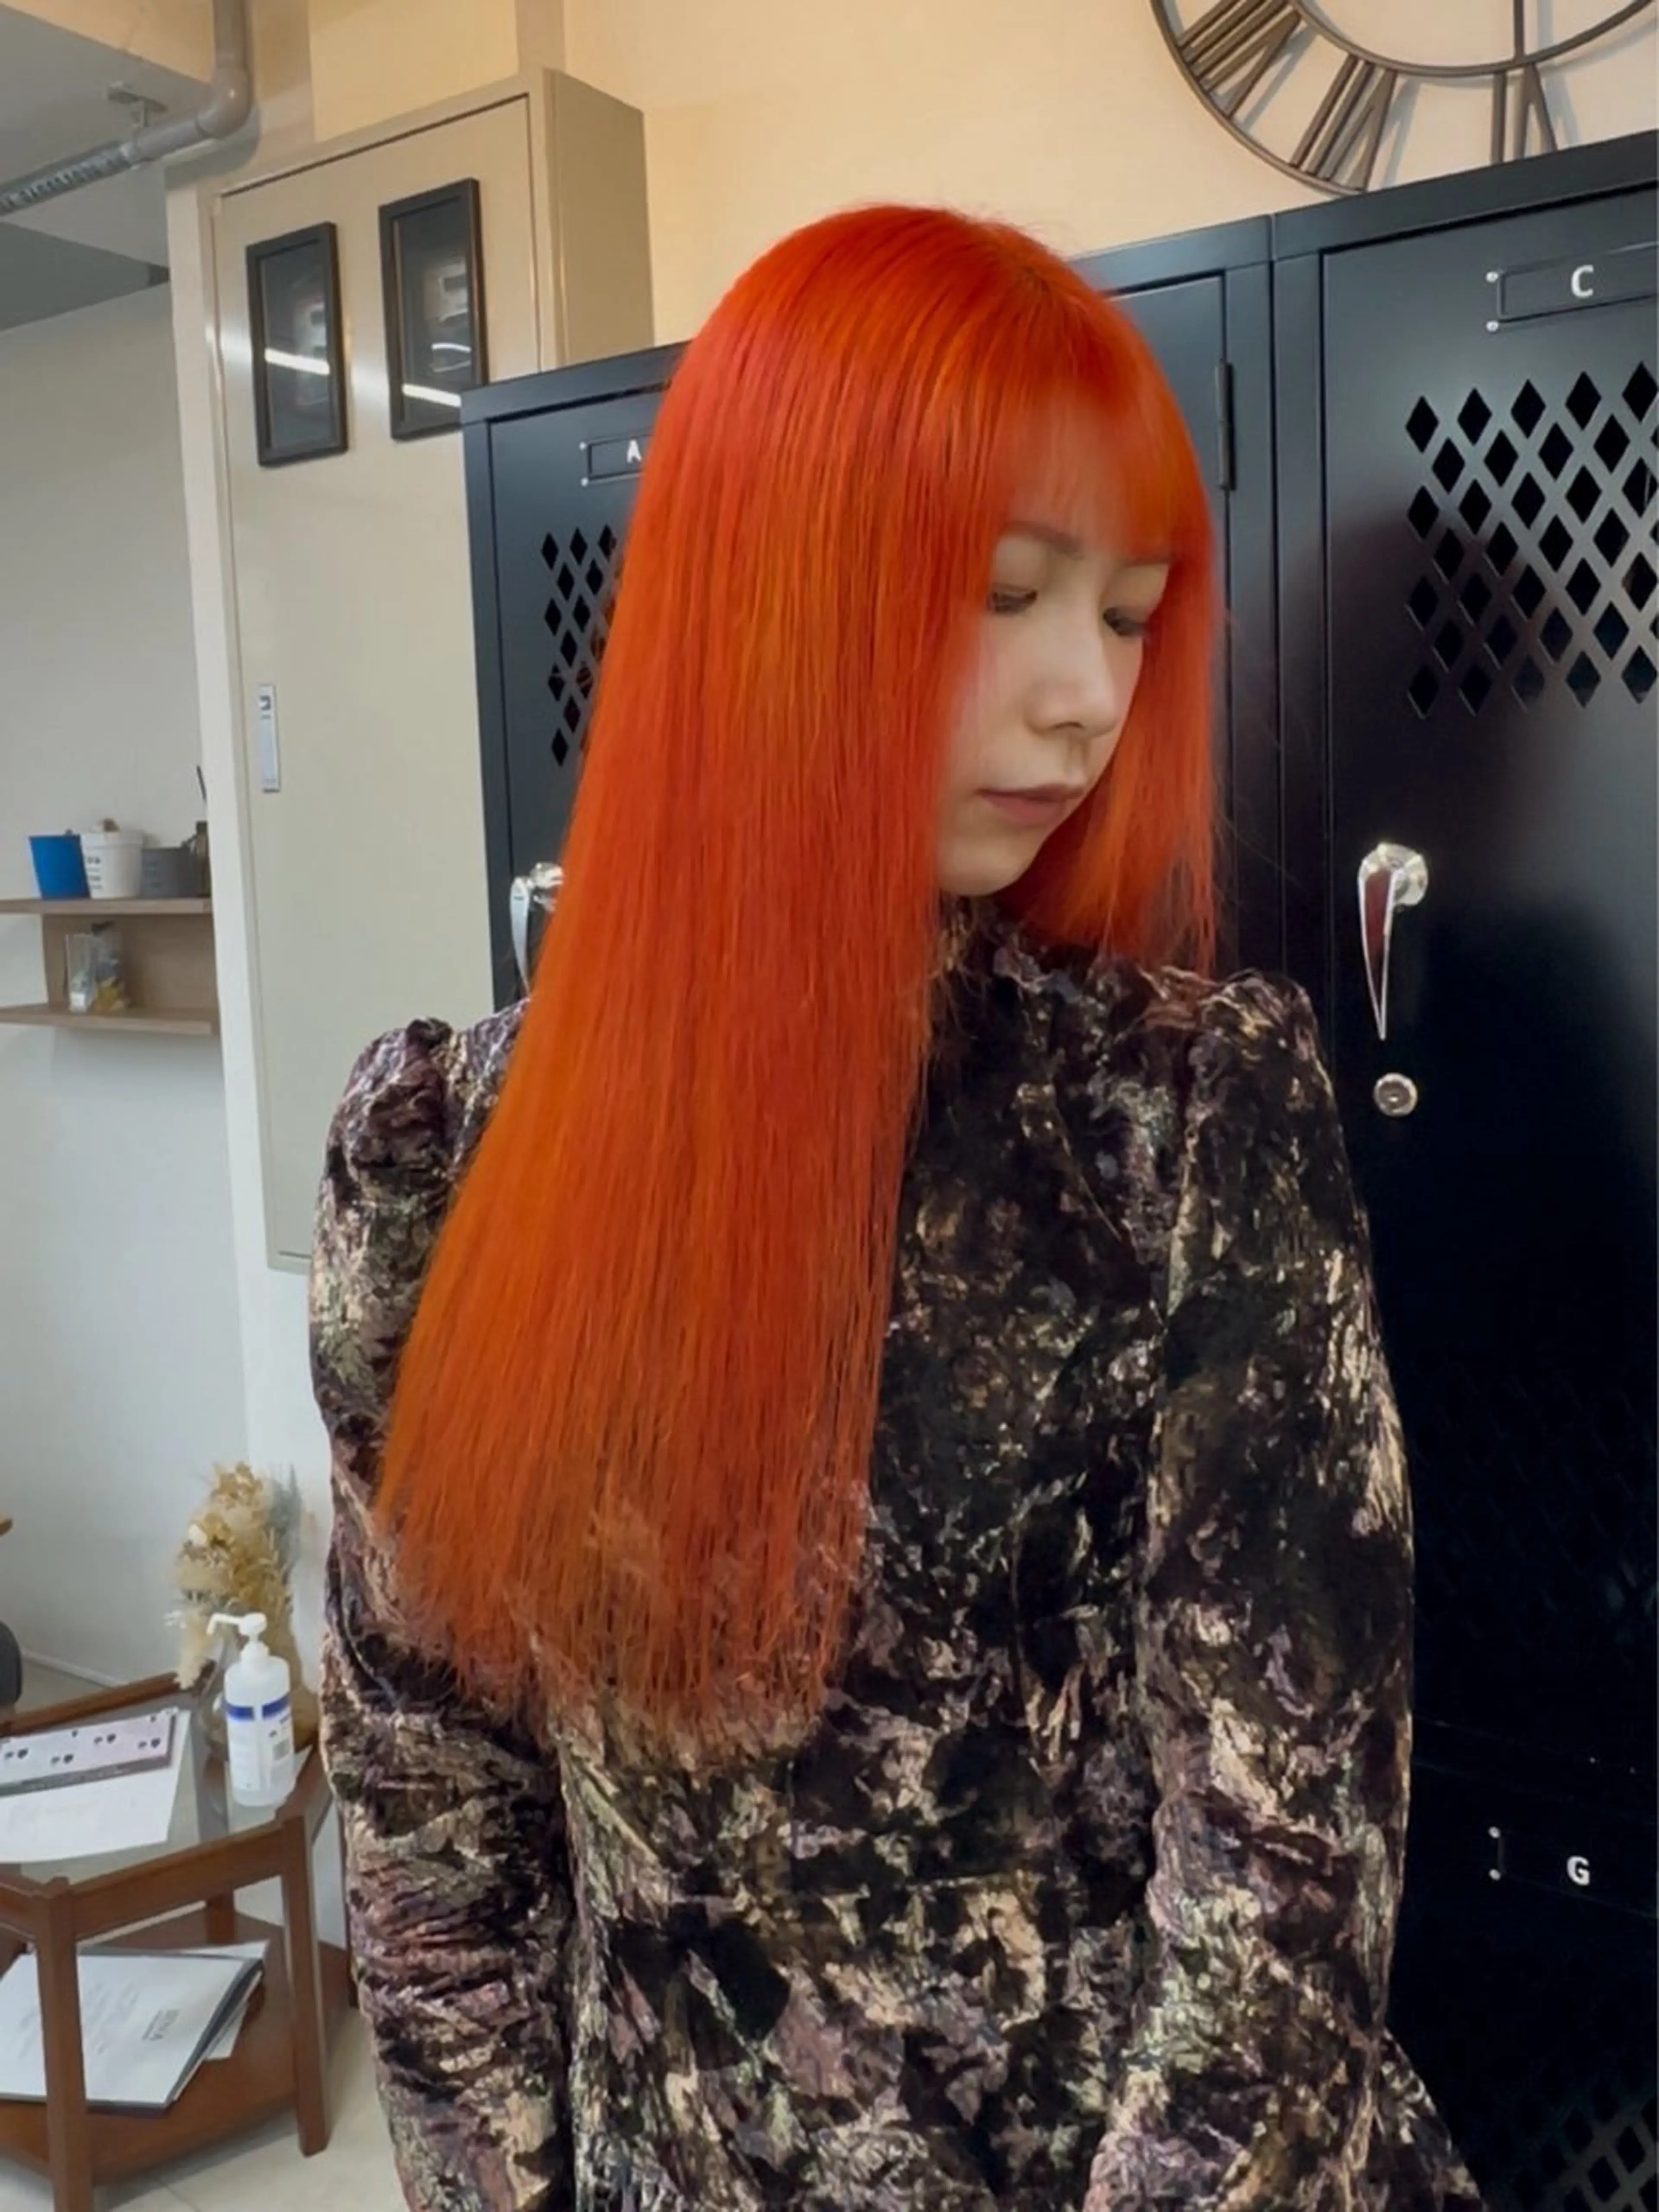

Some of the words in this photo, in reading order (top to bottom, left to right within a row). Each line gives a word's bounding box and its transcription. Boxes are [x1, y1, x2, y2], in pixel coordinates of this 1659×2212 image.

[1571, 264, 1594, 298] C
[626, 439, 643, 464] A
[1566, 1856, 1591, 1886] G
